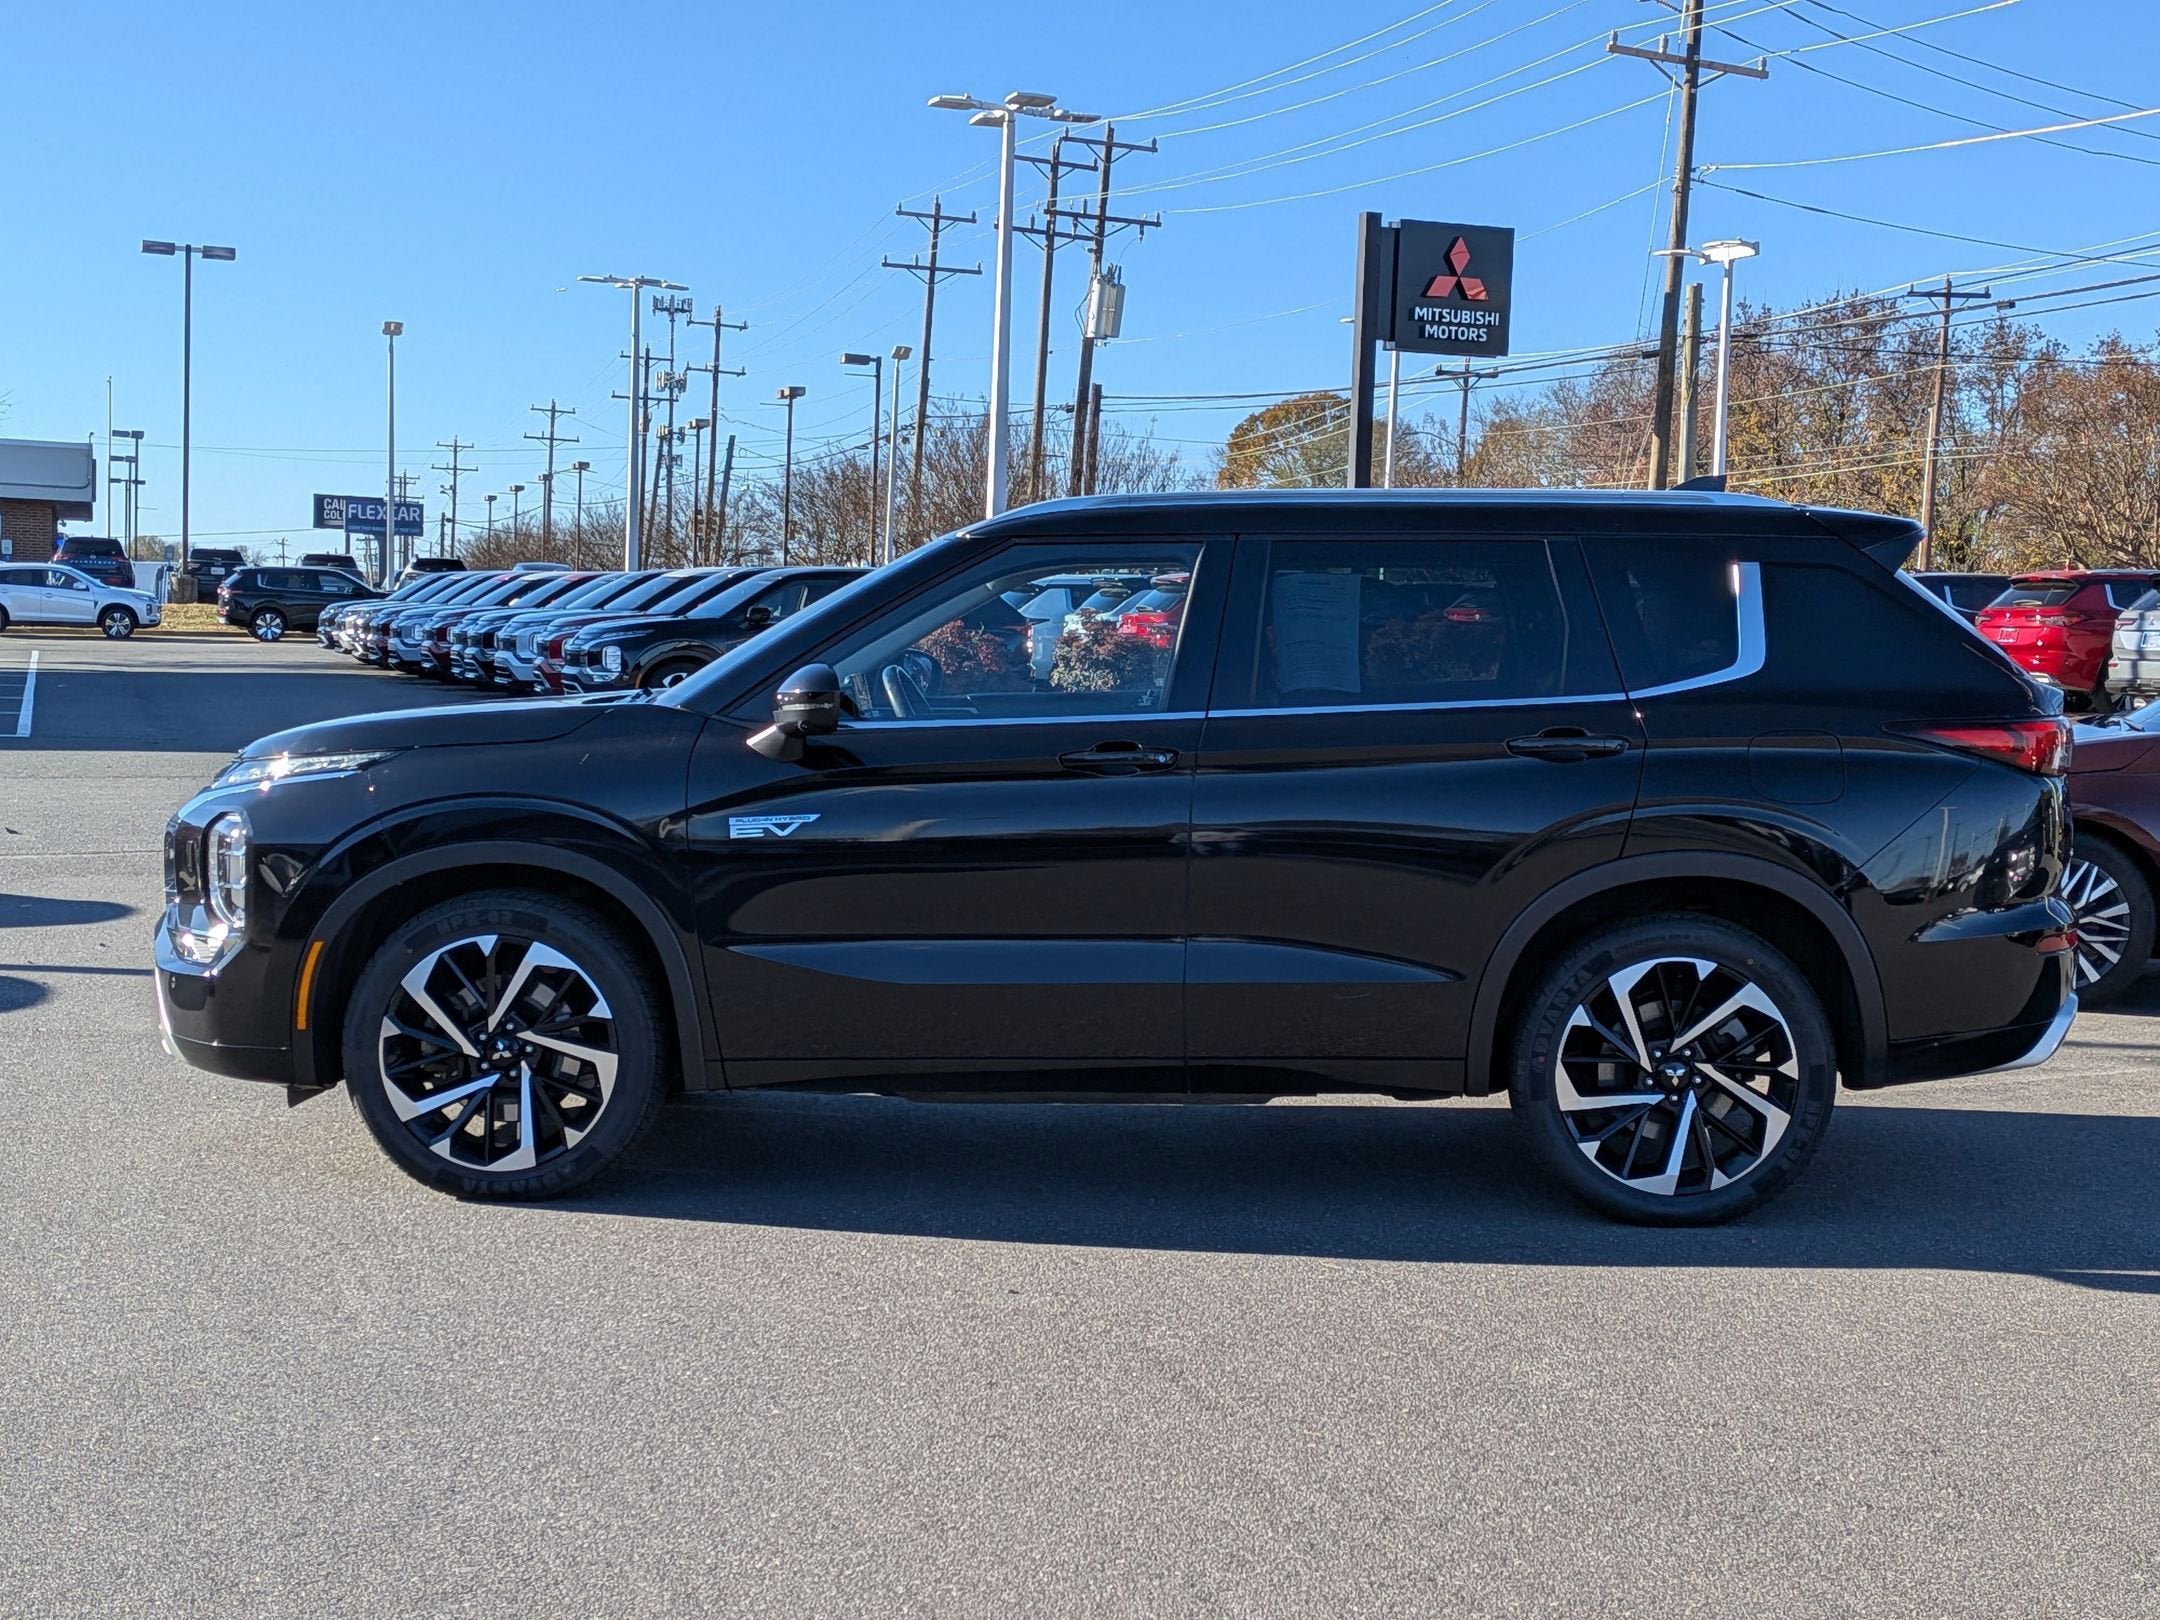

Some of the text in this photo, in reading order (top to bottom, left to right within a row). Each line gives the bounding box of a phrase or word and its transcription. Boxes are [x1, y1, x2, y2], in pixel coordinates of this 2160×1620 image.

[1414, 306, 1500, 326] MITSUBISHI
[1424, 324, 1488, 341] MOTORS
[729, 821, 803, 839] EV
